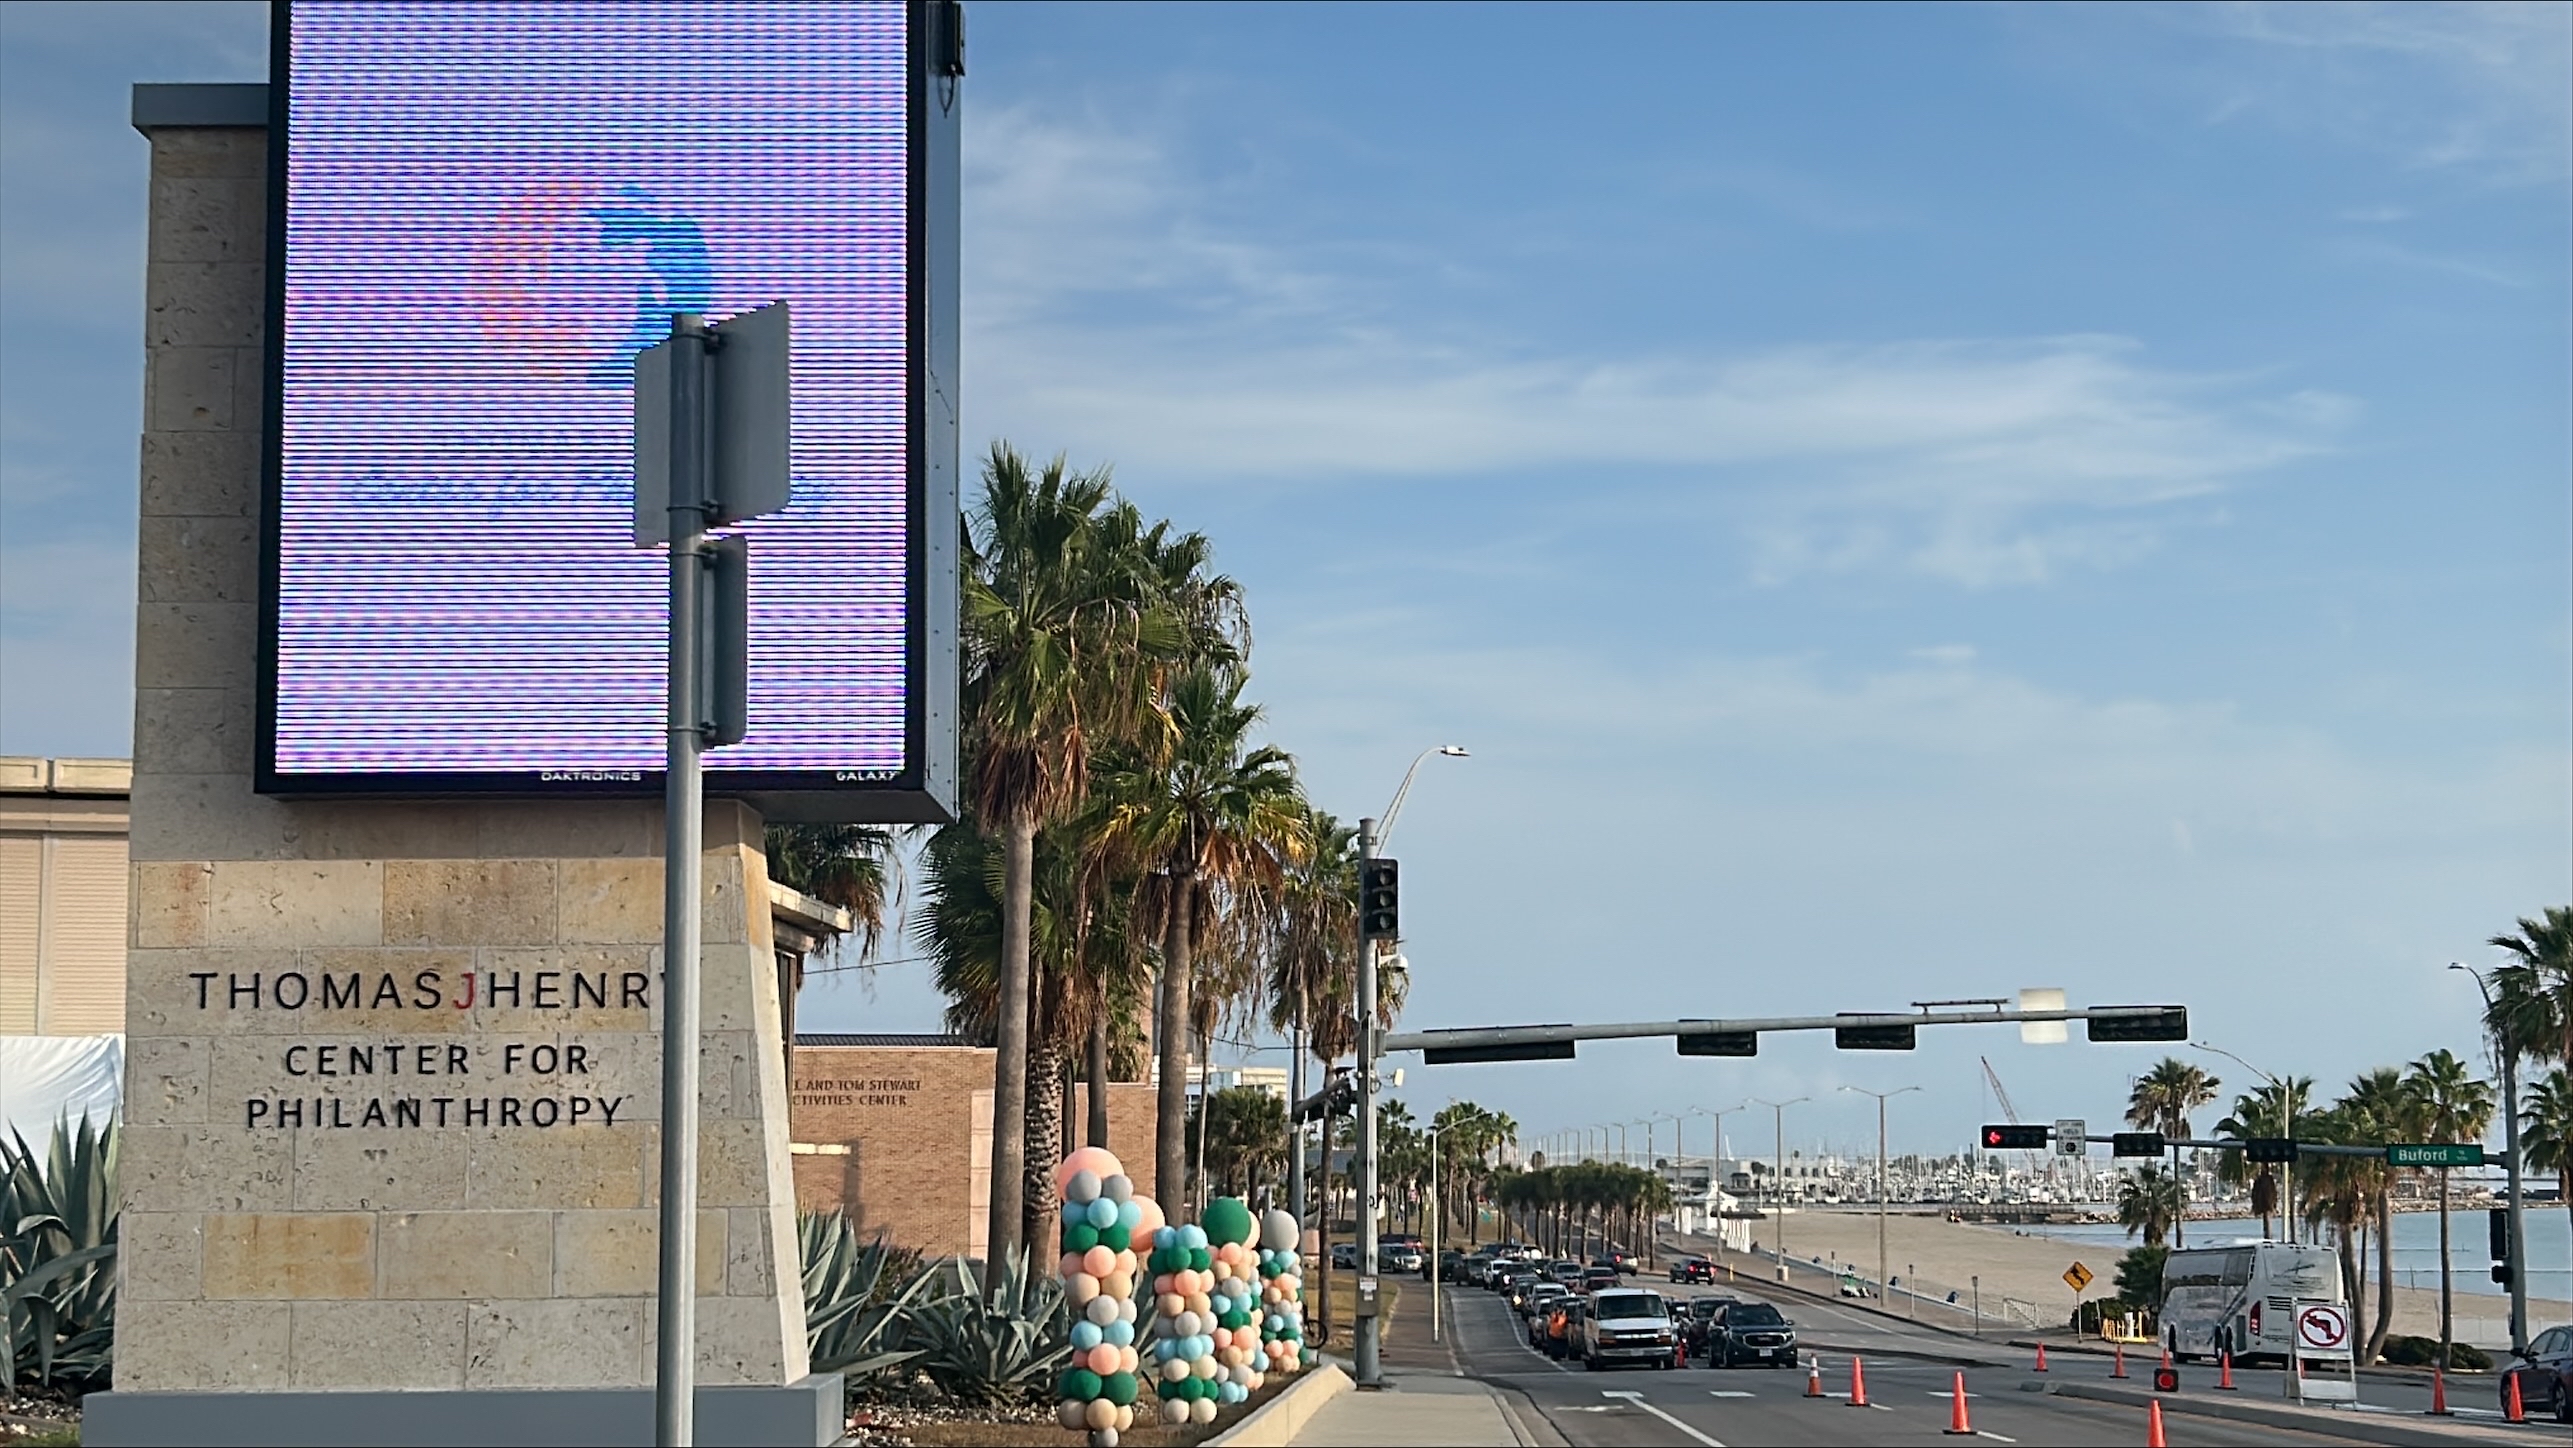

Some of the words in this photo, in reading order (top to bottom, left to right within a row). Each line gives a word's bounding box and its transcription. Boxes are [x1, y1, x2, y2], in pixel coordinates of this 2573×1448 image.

[540, 771, 641, 781] DAKTRONICS
[835, 770, 897, 781] GALAXY
[286, 1045, 469, 1075] CENTER
[505, 1044, 588, 1075] FOR
[806, 1080, 833, 1091] AND
[838, 1080, 865, 1091] TOM
[869, 1079, 921, 1091] STEWART
[793, 1094, 853, 1106] CTIVITIES
[859, 1094, 907, 1106] CENTER
[247, 1097, 623, 1129] PHILANTHROPY
[2398, 1149, 2448, 1161] Buford
